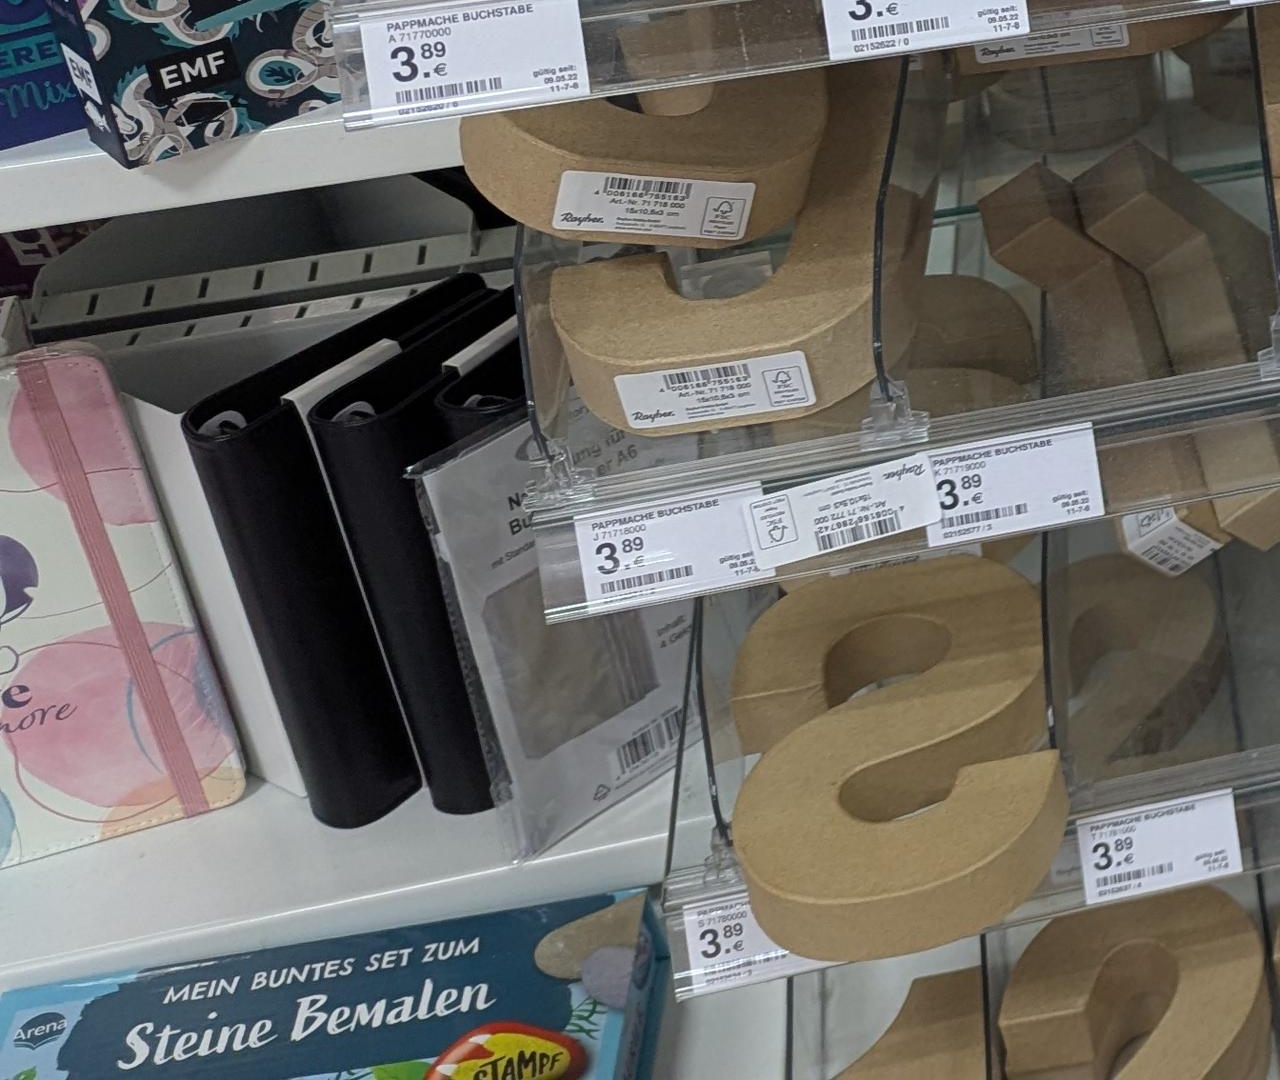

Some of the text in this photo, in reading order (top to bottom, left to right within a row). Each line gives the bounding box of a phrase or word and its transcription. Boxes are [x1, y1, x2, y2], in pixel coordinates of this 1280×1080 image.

[386, 3, 535, 33] PAPPMACHE BUCHSTABE
[398, 26, 452, 40] 71770000
[158, 49, 226, 92] EMF
[933, 438, 1053, 467] PAPPMACHE BUCHSTABE
[591, 498, 720, 532] PAPPMACHE BUCHSTABE
[163, 937, 480, 1006] MEIN BUNTES SET ZUM
[13, 1017, 69, 1040] Arena
[116, 977, 498, 1071] Steine Bemalen
